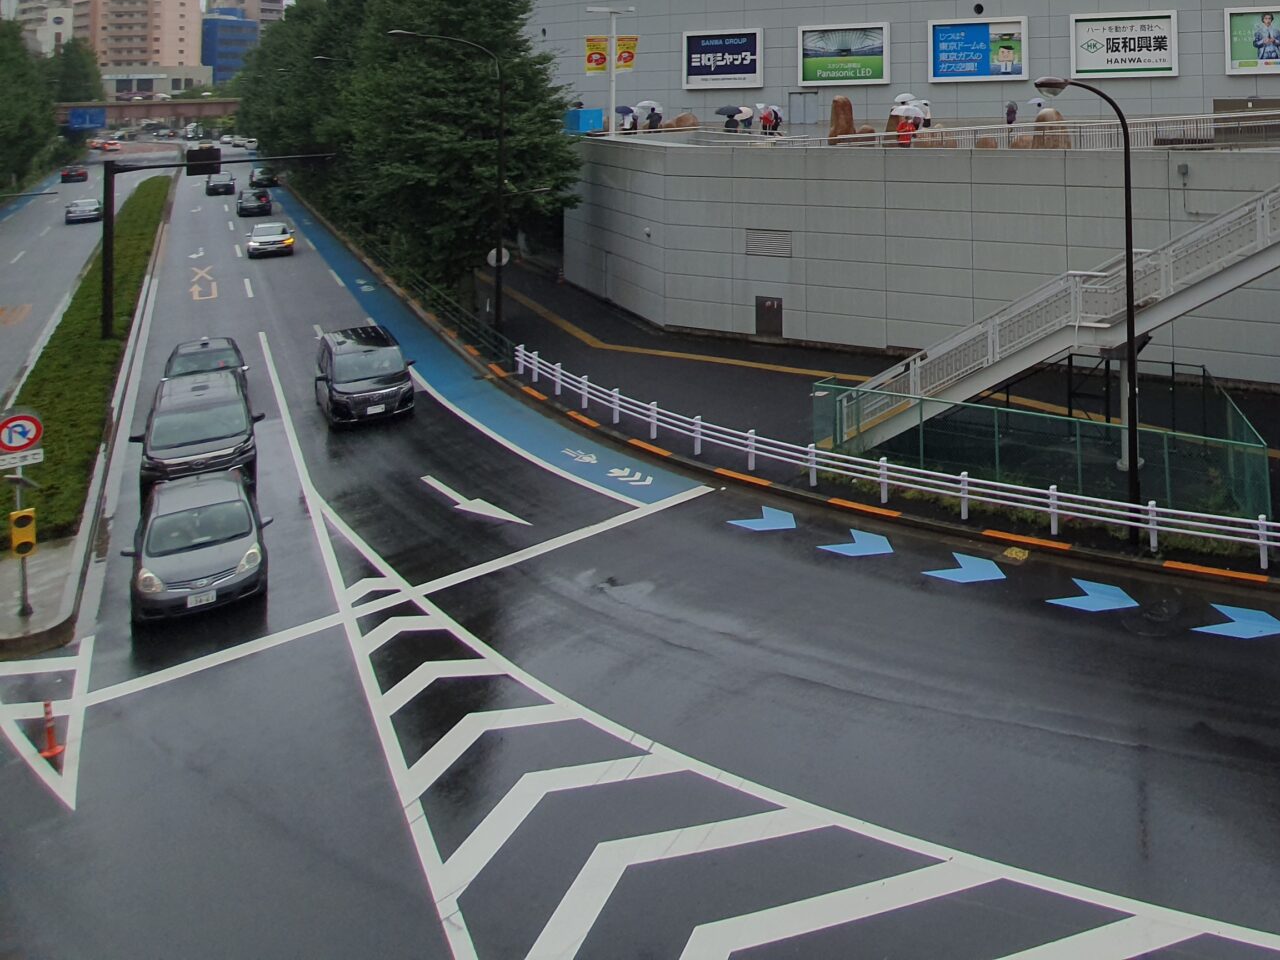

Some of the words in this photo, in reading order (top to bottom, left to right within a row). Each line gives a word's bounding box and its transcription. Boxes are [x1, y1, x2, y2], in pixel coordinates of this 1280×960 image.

[939, 42, 986, 50] 東京ドームも
[1106, 35, 1168, 53] 阪和興業
[939, 52, 982, 60] 東京ガスの
[691, 52, 756, 71] 三和シャッター
[856, 68, 872, 76] LED
